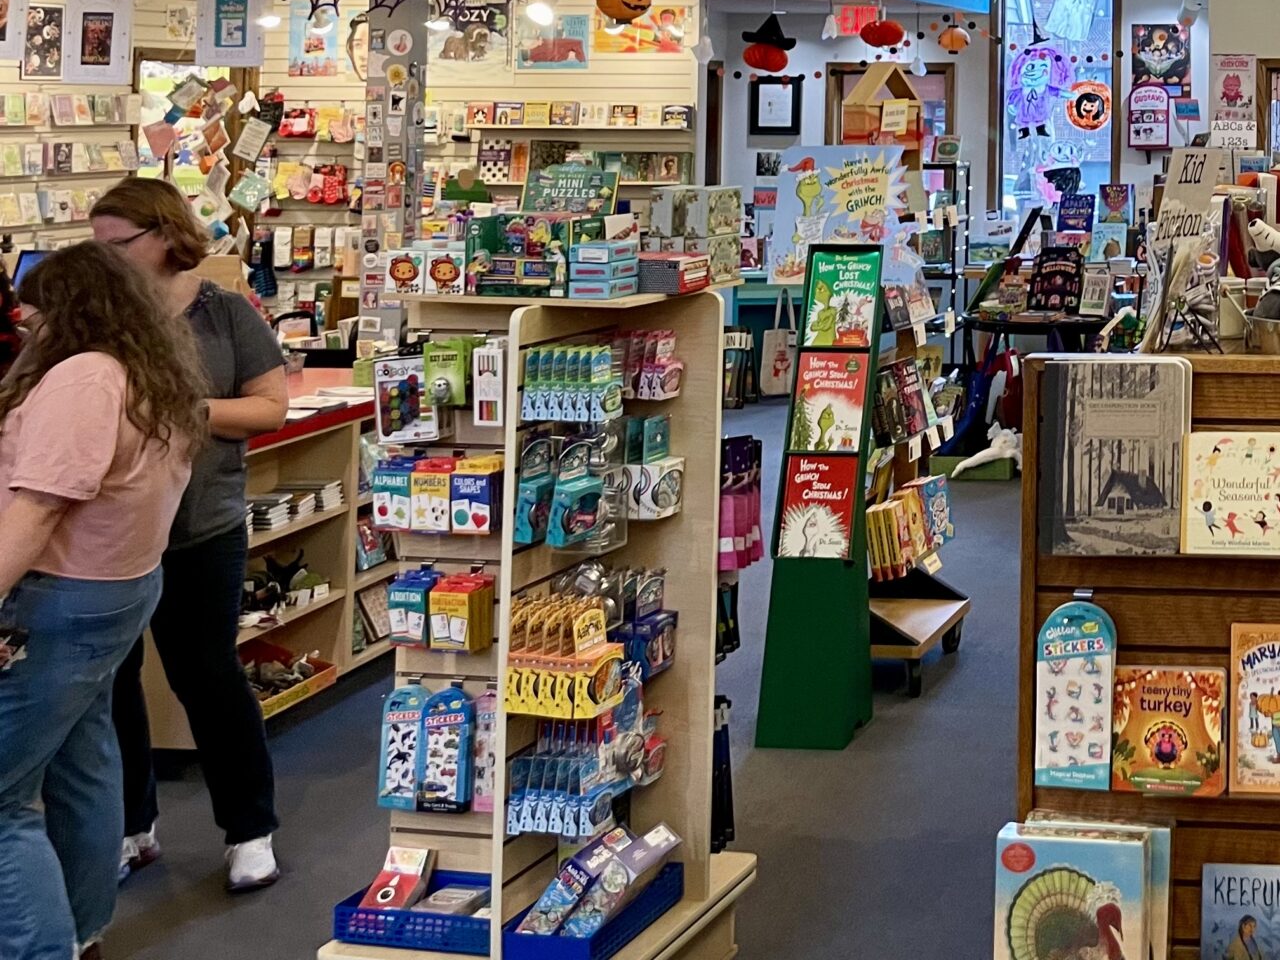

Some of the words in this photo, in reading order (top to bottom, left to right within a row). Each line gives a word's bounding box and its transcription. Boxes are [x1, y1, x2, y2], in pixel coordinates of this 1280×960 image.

[1133, 94, 1165, 104] GUSTAVO
[1213, 122, 1243, 131] ABCs
[1245, 122, 1256, 131] &
[1221, 136, 1248, 146] 123s
[843, 158, 862, 168] Have
[1178, 153, 1207, 184] Kid
[870, 166, 893, 175] Awful
[557, 178, 583, 188] MINI
[841, 177, 879, 189] Christmas
[542, 187, 596, 198] PUZZLES
[848, 187, 863, 197] with
[864, 185, 876, 193] the
[1155, 208, 1203, 241] Fiction
[839, 271, 860, 280] LOST
[833, 281, 874, 291] CHRISTMAS!
[813, 378, 858, 390] CHRISTMAS!
[374, 475, 408, 486] ALPHABET
[413, 477, 447, 487] NUMBERS
[453, 477, 475, 486] COLORS
[1211, 477, 1272, 493] Wonderful
[802, 488, 849, 500] CHRISTMAS!
[1218, 490, 1263, 502] Seasons
[1045, 626, 1077, 640] Glitter
[1141, 685, 1171, 698] teeny
[1172, 684, 1192, 697] tiny
[1140, 697, 1192, 717] turkey
[425, 713, 465, 727] STICKERS
